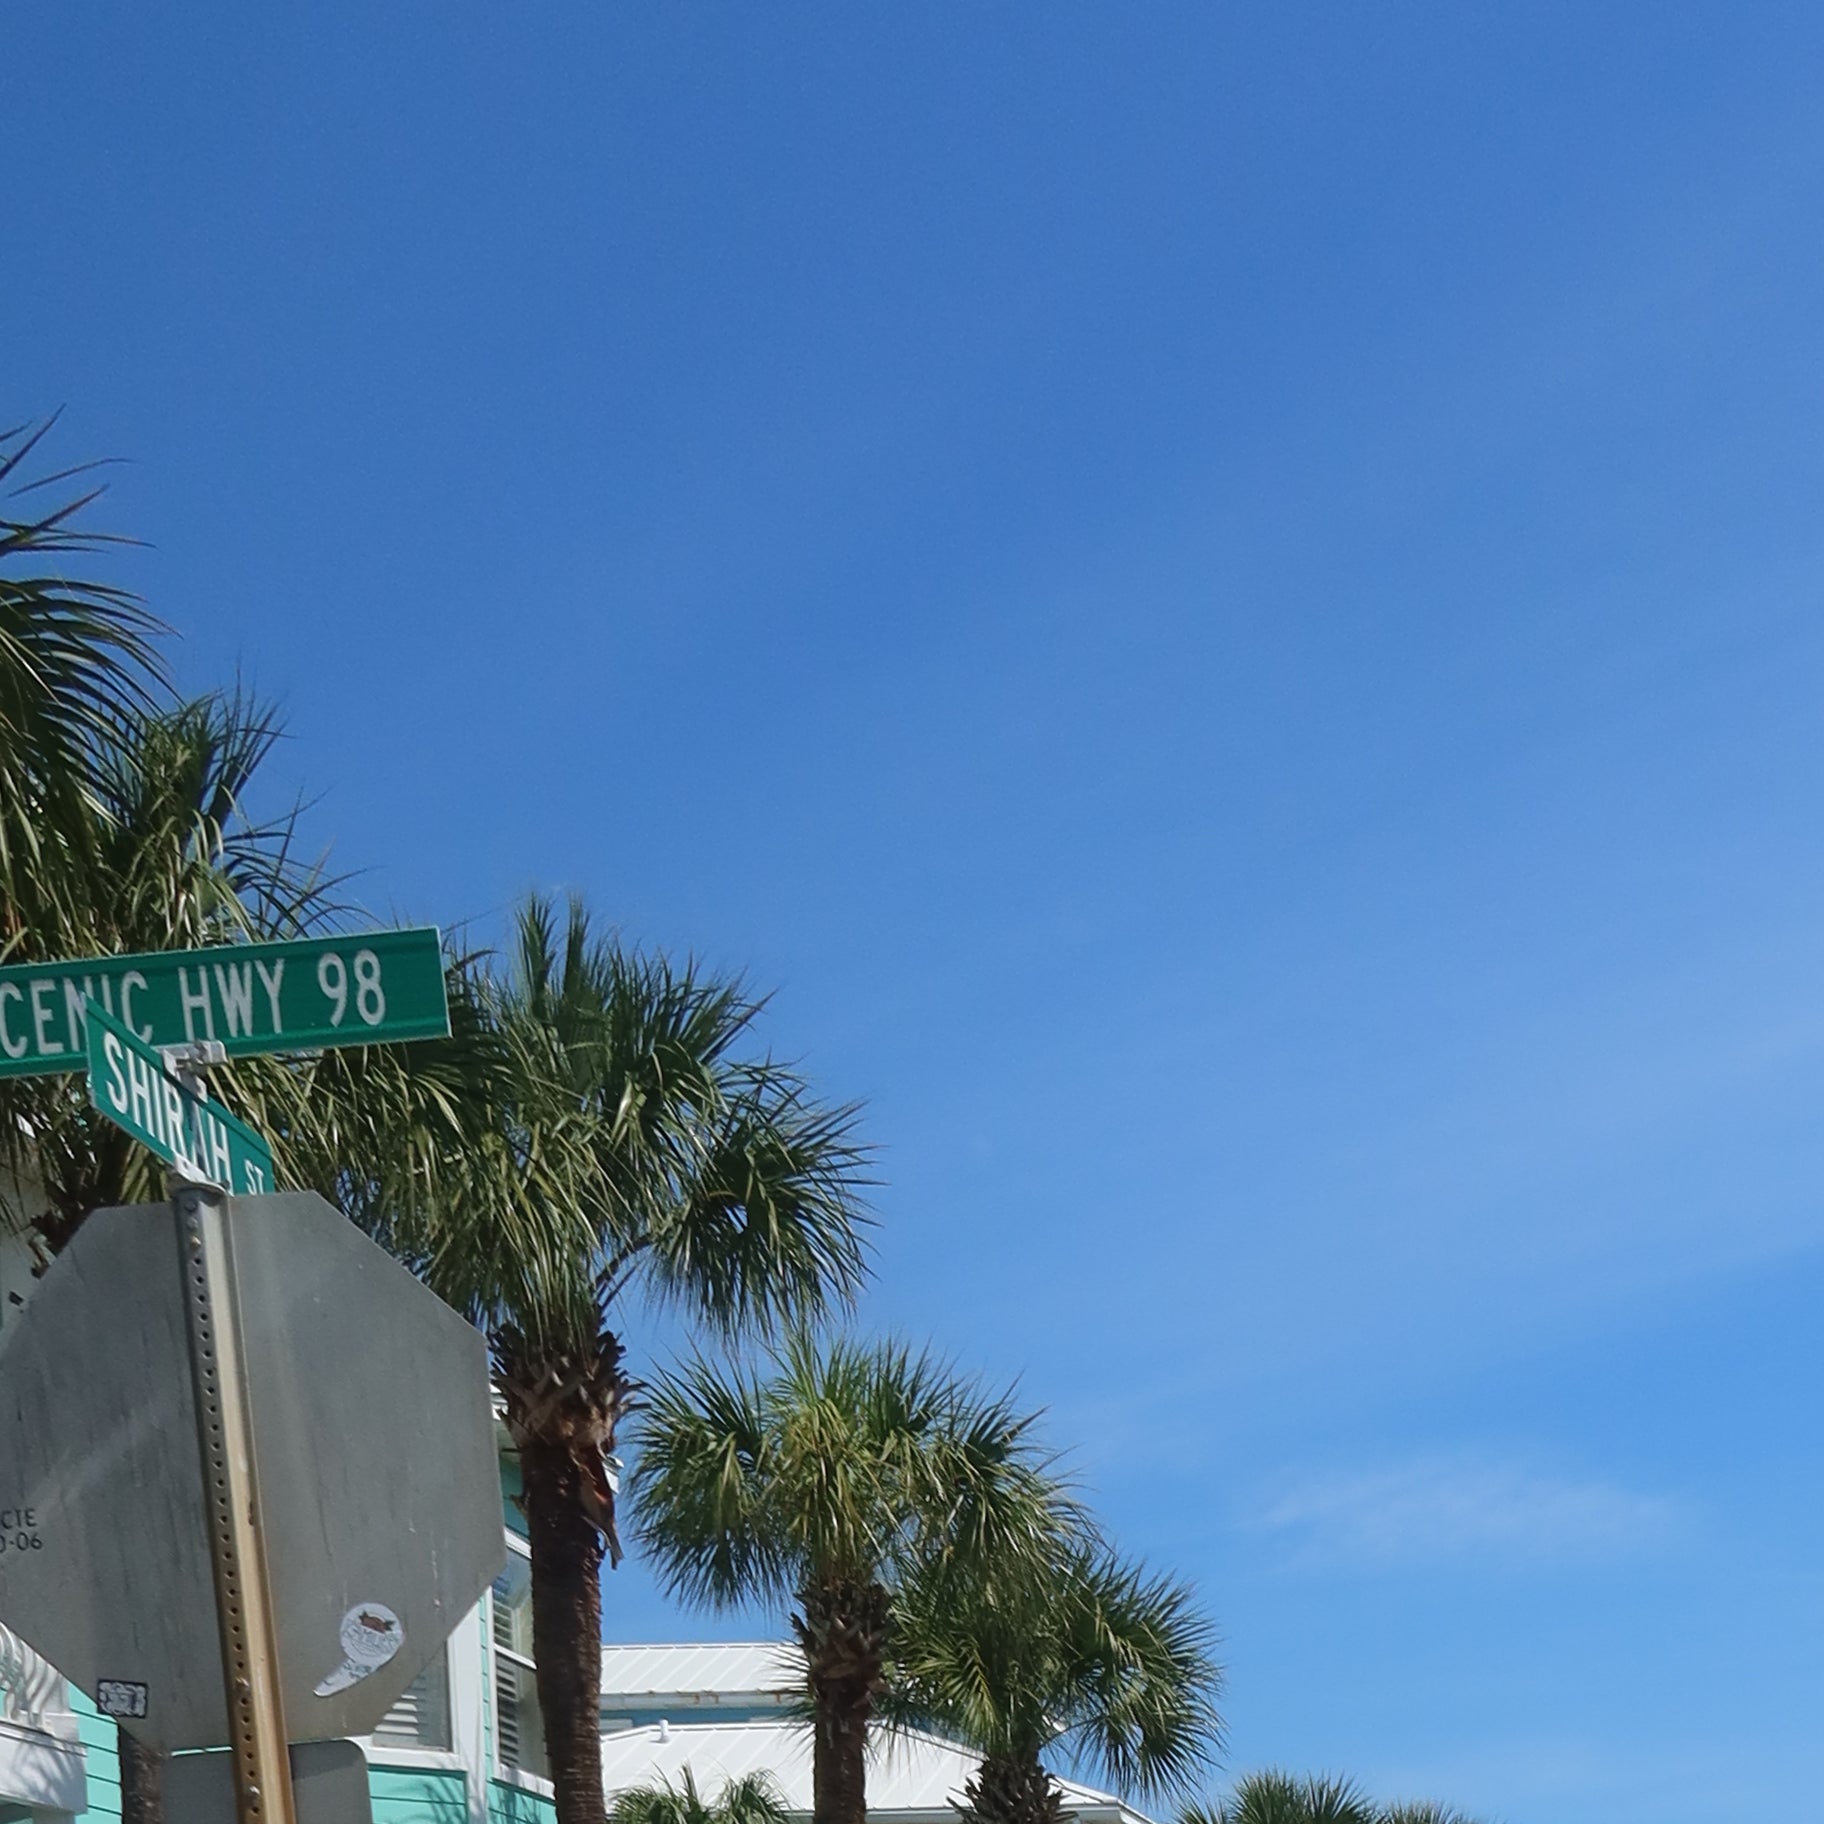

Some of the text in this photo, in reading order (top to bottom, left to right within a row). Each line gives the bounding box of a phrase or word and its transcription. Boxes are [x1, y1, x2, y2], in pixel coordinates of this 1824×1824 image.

[178, 957, 285, 1042] HWY
[317, 949, 387, 1029] 98
[104, 1031, 264, 1197] SHIRAH ST
